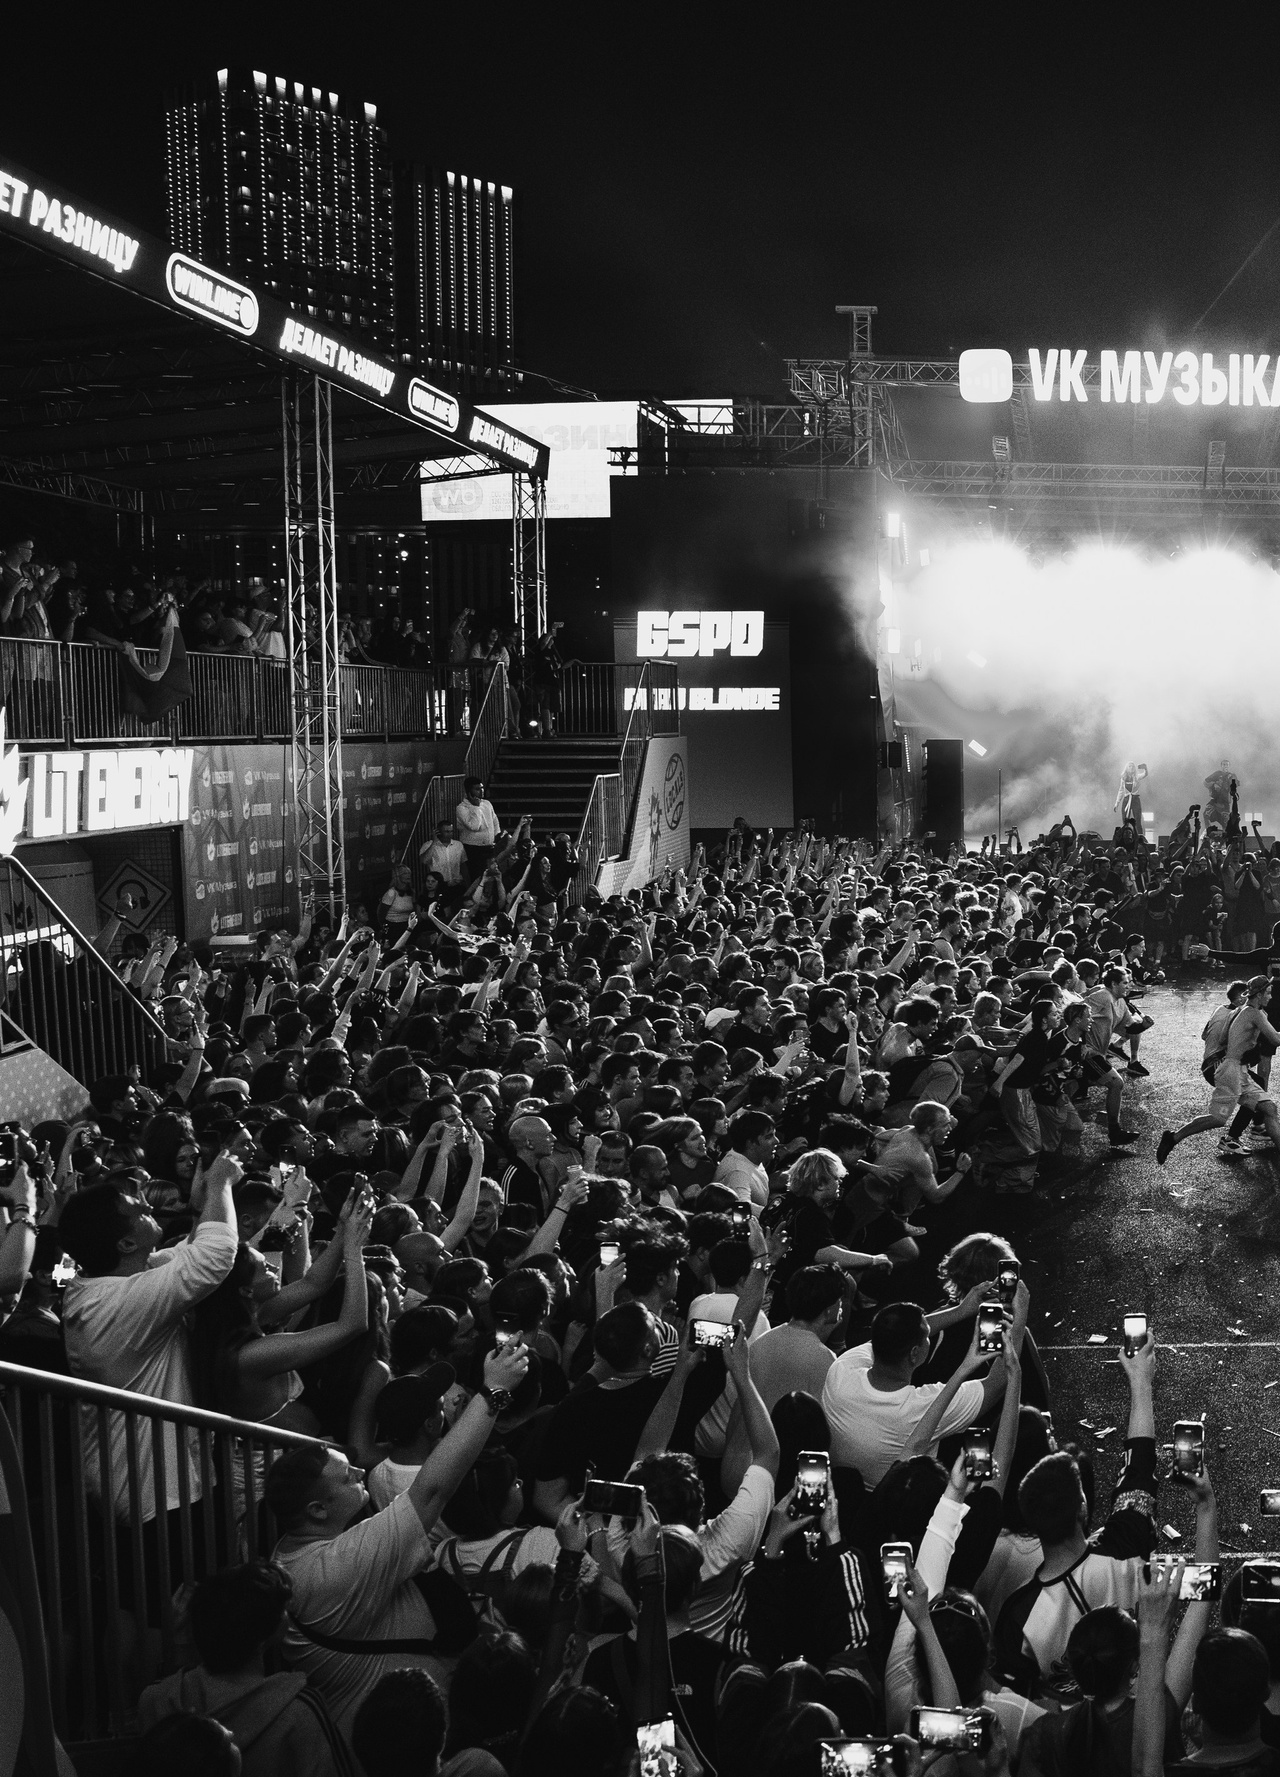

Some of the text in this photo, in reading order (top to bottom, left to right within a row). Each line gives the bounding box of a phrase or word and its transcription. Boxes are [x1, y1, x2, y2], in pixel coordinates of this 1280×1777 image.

[30, 188, 140, 273] РАЗНИЦУ
[174, 263, 242, 321] WINLINE
[279, 317, 396, 397] ДЕЛАЕТ РАЗНИЦУ
[1027, 348, 1088, 402] VK
[637, 611, 765, 656] GSPD
[688, 688, 780, 711] BLONDE
